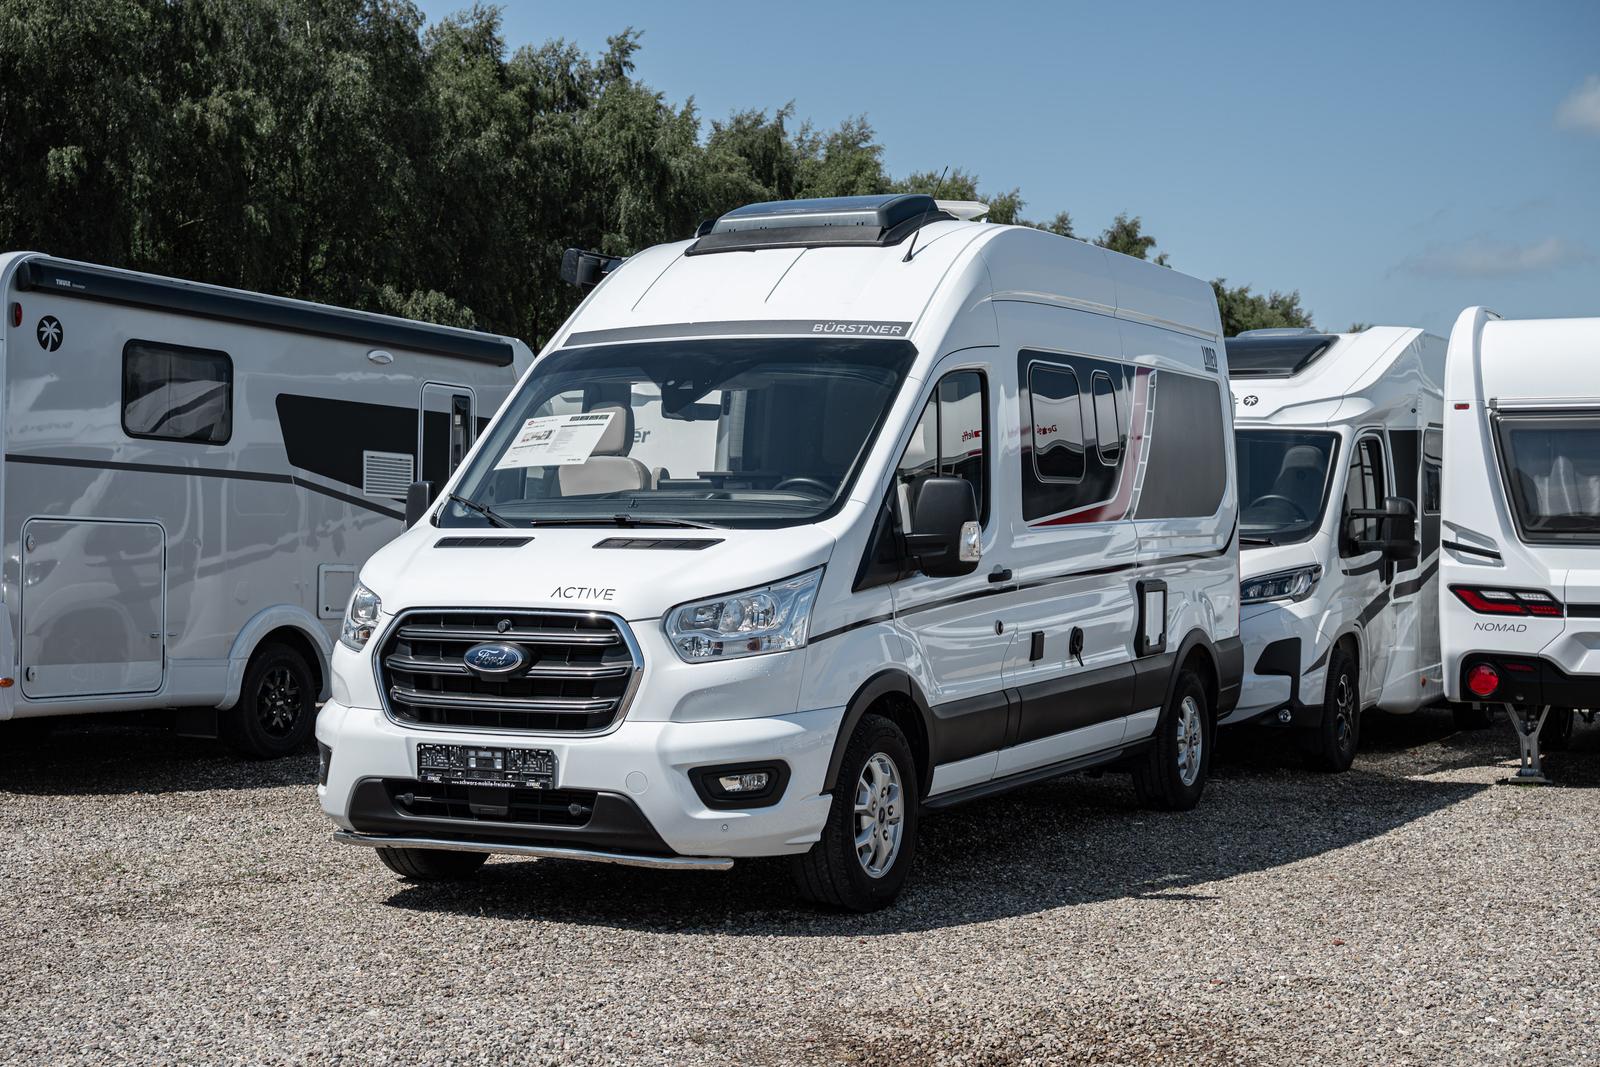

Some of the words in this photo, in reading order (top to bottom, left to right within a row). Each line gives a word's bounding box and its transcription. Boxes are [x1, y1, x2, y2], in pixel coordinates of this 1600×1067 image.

[812, 321, 903, 334] BÜRSTNER
[550, 586, 616, 600] ACTIVE
[1473, 622, 1528, 633] NOMAD
[474, 649, 507, 666] Ford
